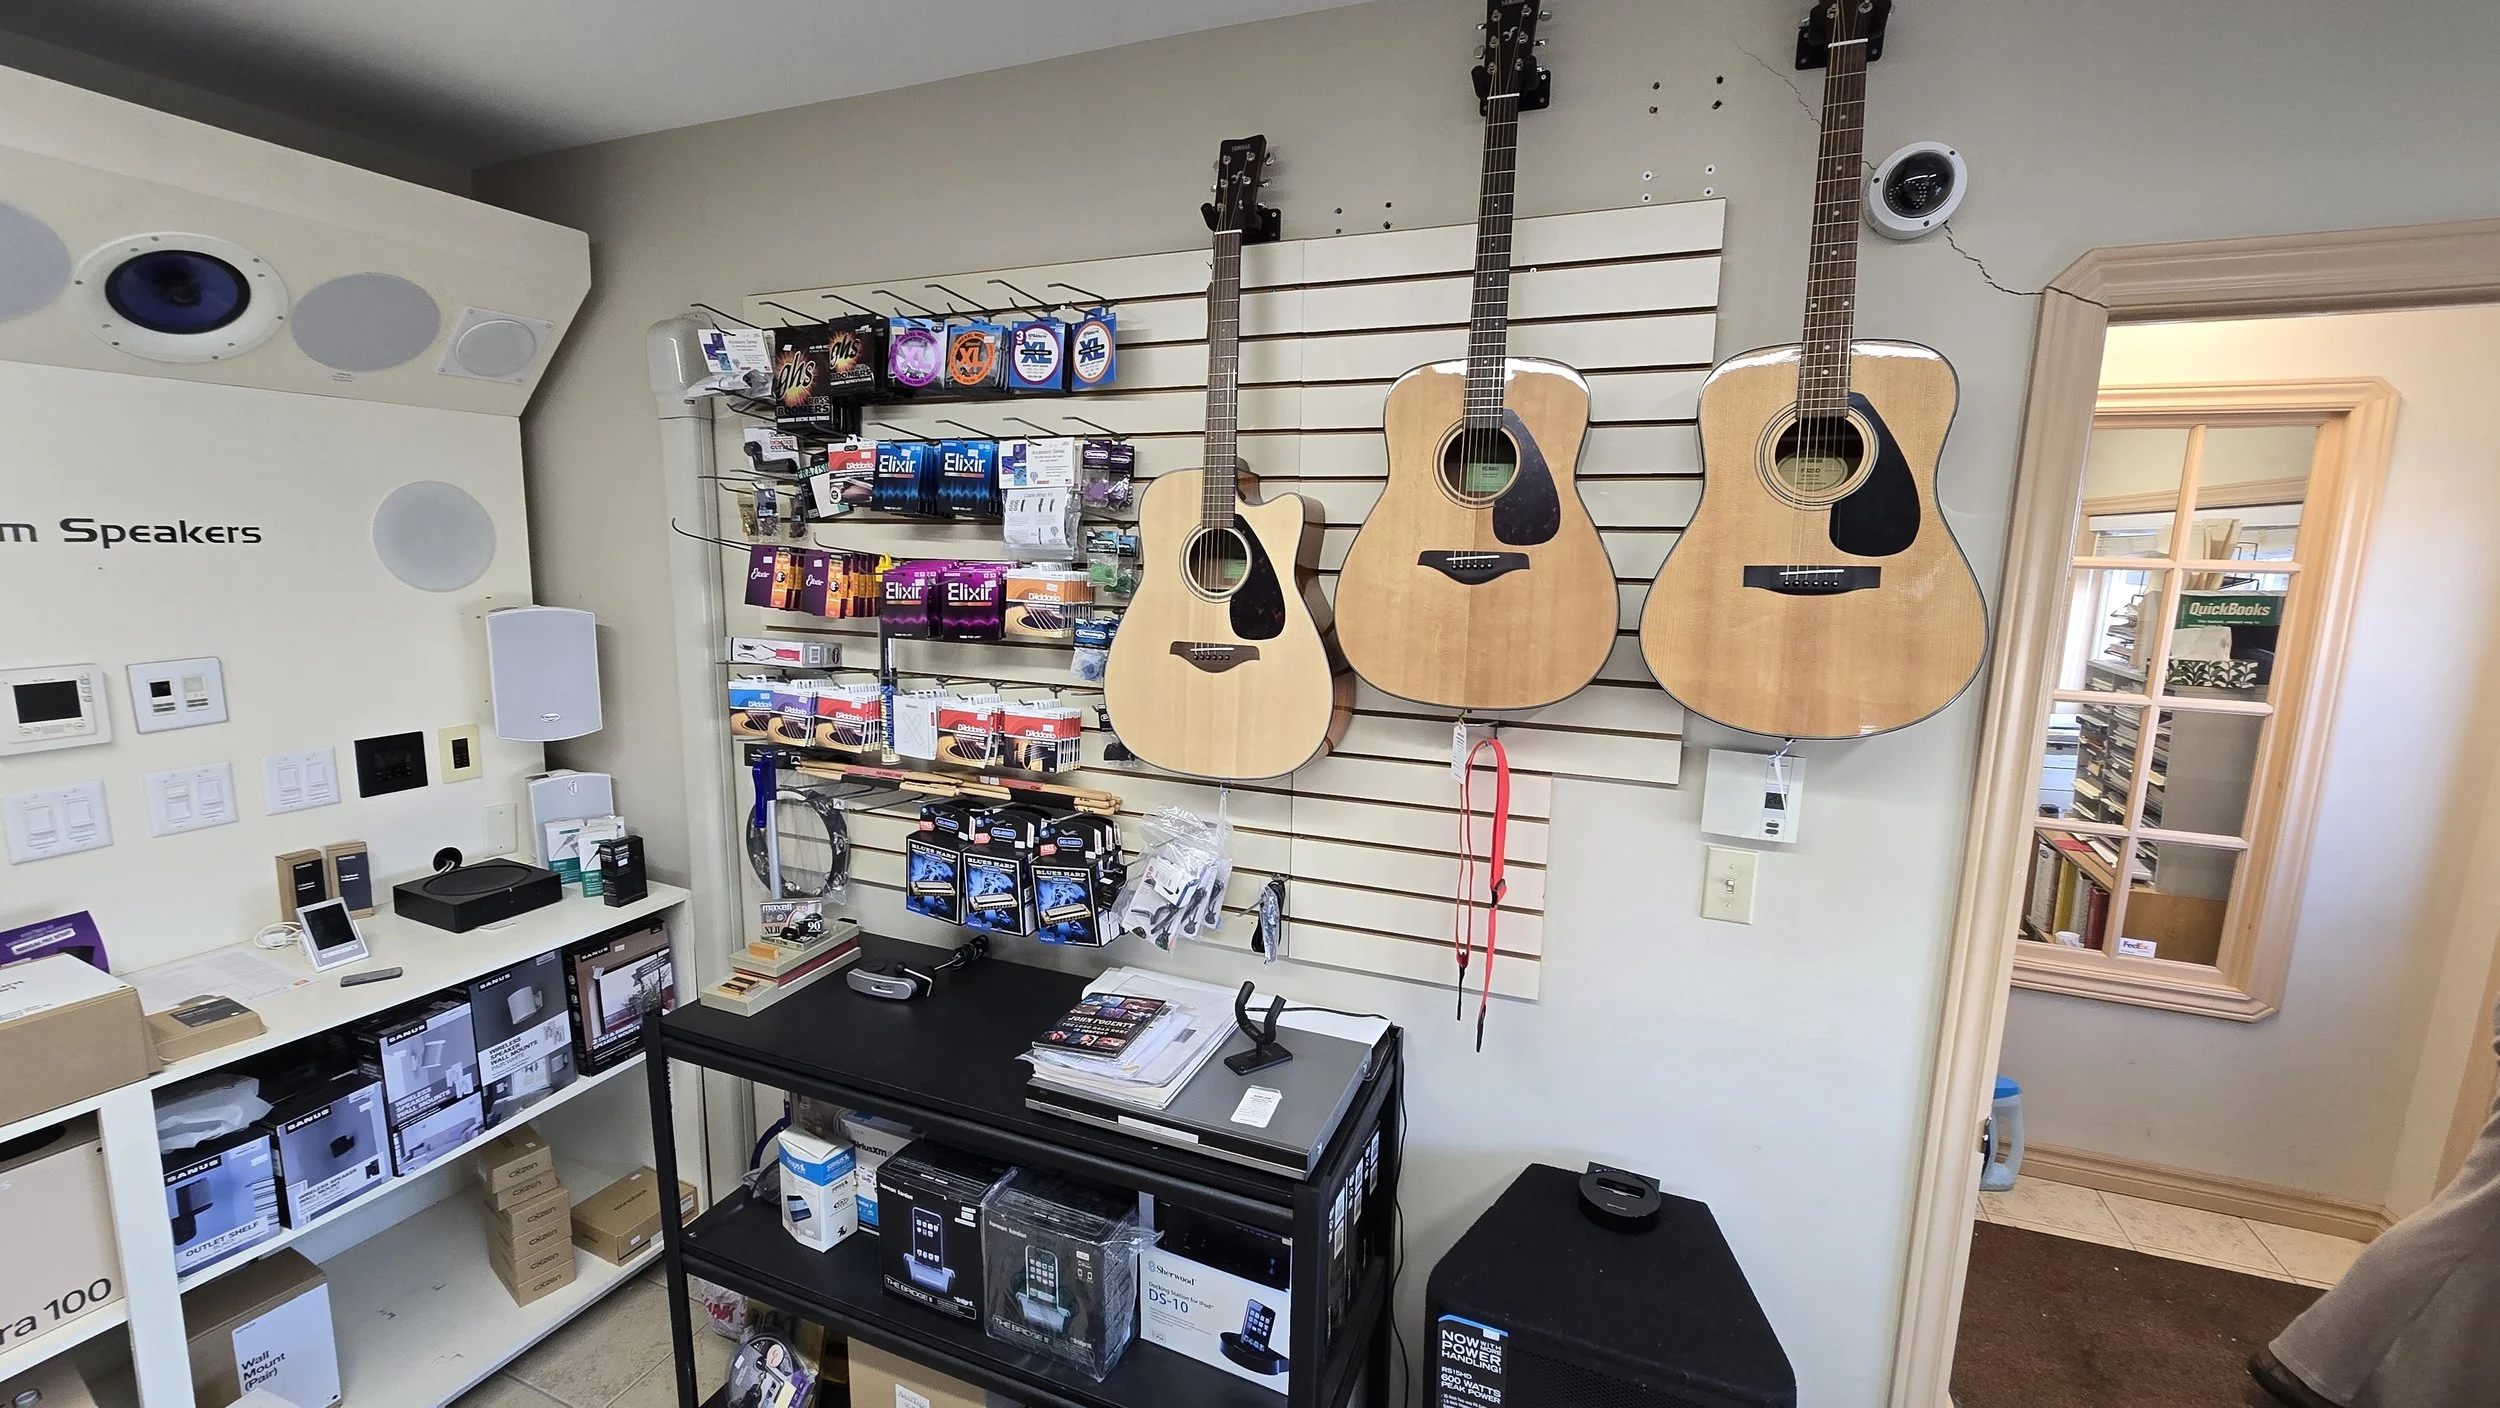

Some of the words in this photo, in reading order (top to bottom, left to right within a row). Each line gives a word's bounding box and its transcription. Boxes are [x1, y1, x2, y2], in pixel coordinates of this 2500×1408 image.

[1016, 330, 1024, 339] 3
[960, 346, 984, 367] XL
[1020, 341, 1052, 364] XL
[1079, 337, 1105, 364] XL
[772, 350, 816, 399] ghs
[777, 403, 830, 416] BOOMERS
[878, 455, 915, 473] Elixir
[944, 452, 985, 473] Elixir
[59, 517, 262, 549] Speakers
[886, 582, 922, 599] Elixir
[947, 582, 992, 600] Elixir
[2189, 602, 2271, 617] QuickBooks
[911, 843, 935, 853] BLUES
[936, 850, 957, 860] HARP
[967, 857, 992, 866] BLUES
[993, 861, 1016, 869] HARP
[1036, 869, 1062, 877] BLUES
[762, 903, 793, 912] maxell
[807, 921, 820, 932] 90
[581, 946, 609, 960] SANUS
[2123, 941, 2148, 950] FedEx
[479, 973, 511, 989] SANUS
[617, 1024, 640, 1040] MOUNTS
[1068, 1015, 1093, 1023] JOHN
[1093, 1017, 1137, 1029] FOGERTY
[388, 1024, 425, 1043] SANUS
[488, 1036, 522, 1055] WIRELESS
[489, 1042, 522, 1061] SPEAKER
[490, 1053, 510, 1066] WALL
[509, 1039, 538, 1058] MOUNTS
[395, 1086, 432, 1107] WIRELESS
[395, 1093, 432, 1113] SPEAKER
[396, 1105, 418, 1119] WALL
[418, 1089, 452, 1111] MOUNTS
[287, 1108, 330, 1130] SANUS
[166, 1159, 219, 1183] SANUS
[317, 1181, 341, 1195] MOUNT
[880, 1182, 897, 1194] harman
[897, 1189, 914, 1201] kardon
[186, 1236, 227, 1257] OUTLET
[228, 1220, 260, 1239] SHELF
[988, 1220, 1008, 1233] harman
[1008, 1227, 1027, 1239] kardon
[1156, 1265, 1196, 1286] Sherwood
[43, 1277, 112, 1321] 100
[886, 1277, 900, 1290] THE
[900, 1283, 929, 1302] BRIDGE
[1148, 1280, 1170, 1295] Docking
[1170, 1289, 1190, 1302] Station
[1190, 1296, 1198, 1305] for
[1149, 1288, 1189, 1314] DS-10
[994, 1317, 1011, 1330] THE
[1011, 1324, 1043, 1342] BRIDGE
[1441, 1329, 1480, 1349] NOW
[1441, 1340, 1502, 1367] POWER
[1480, 1340, 1502, 1351] WITH
[1480, 1345, 1502, 1356] MORE
[241, 1350, 270, 1371] Wall
[243, 1353, 287, 1381] Mount
[1441, 1350, 1502, 1375] HANDLING!
[244, 1367, 278, 1392] (Pair)
[1441, 1366, 1473, 1380] RS15HD
[1440, 1381, 1466, 1393] PEAK
[1467, 1389, 1501, 1404] POWER
[1441, 1373, 1461, 1385] 600
[1463, 1380, 1502, 1398] WATTS
